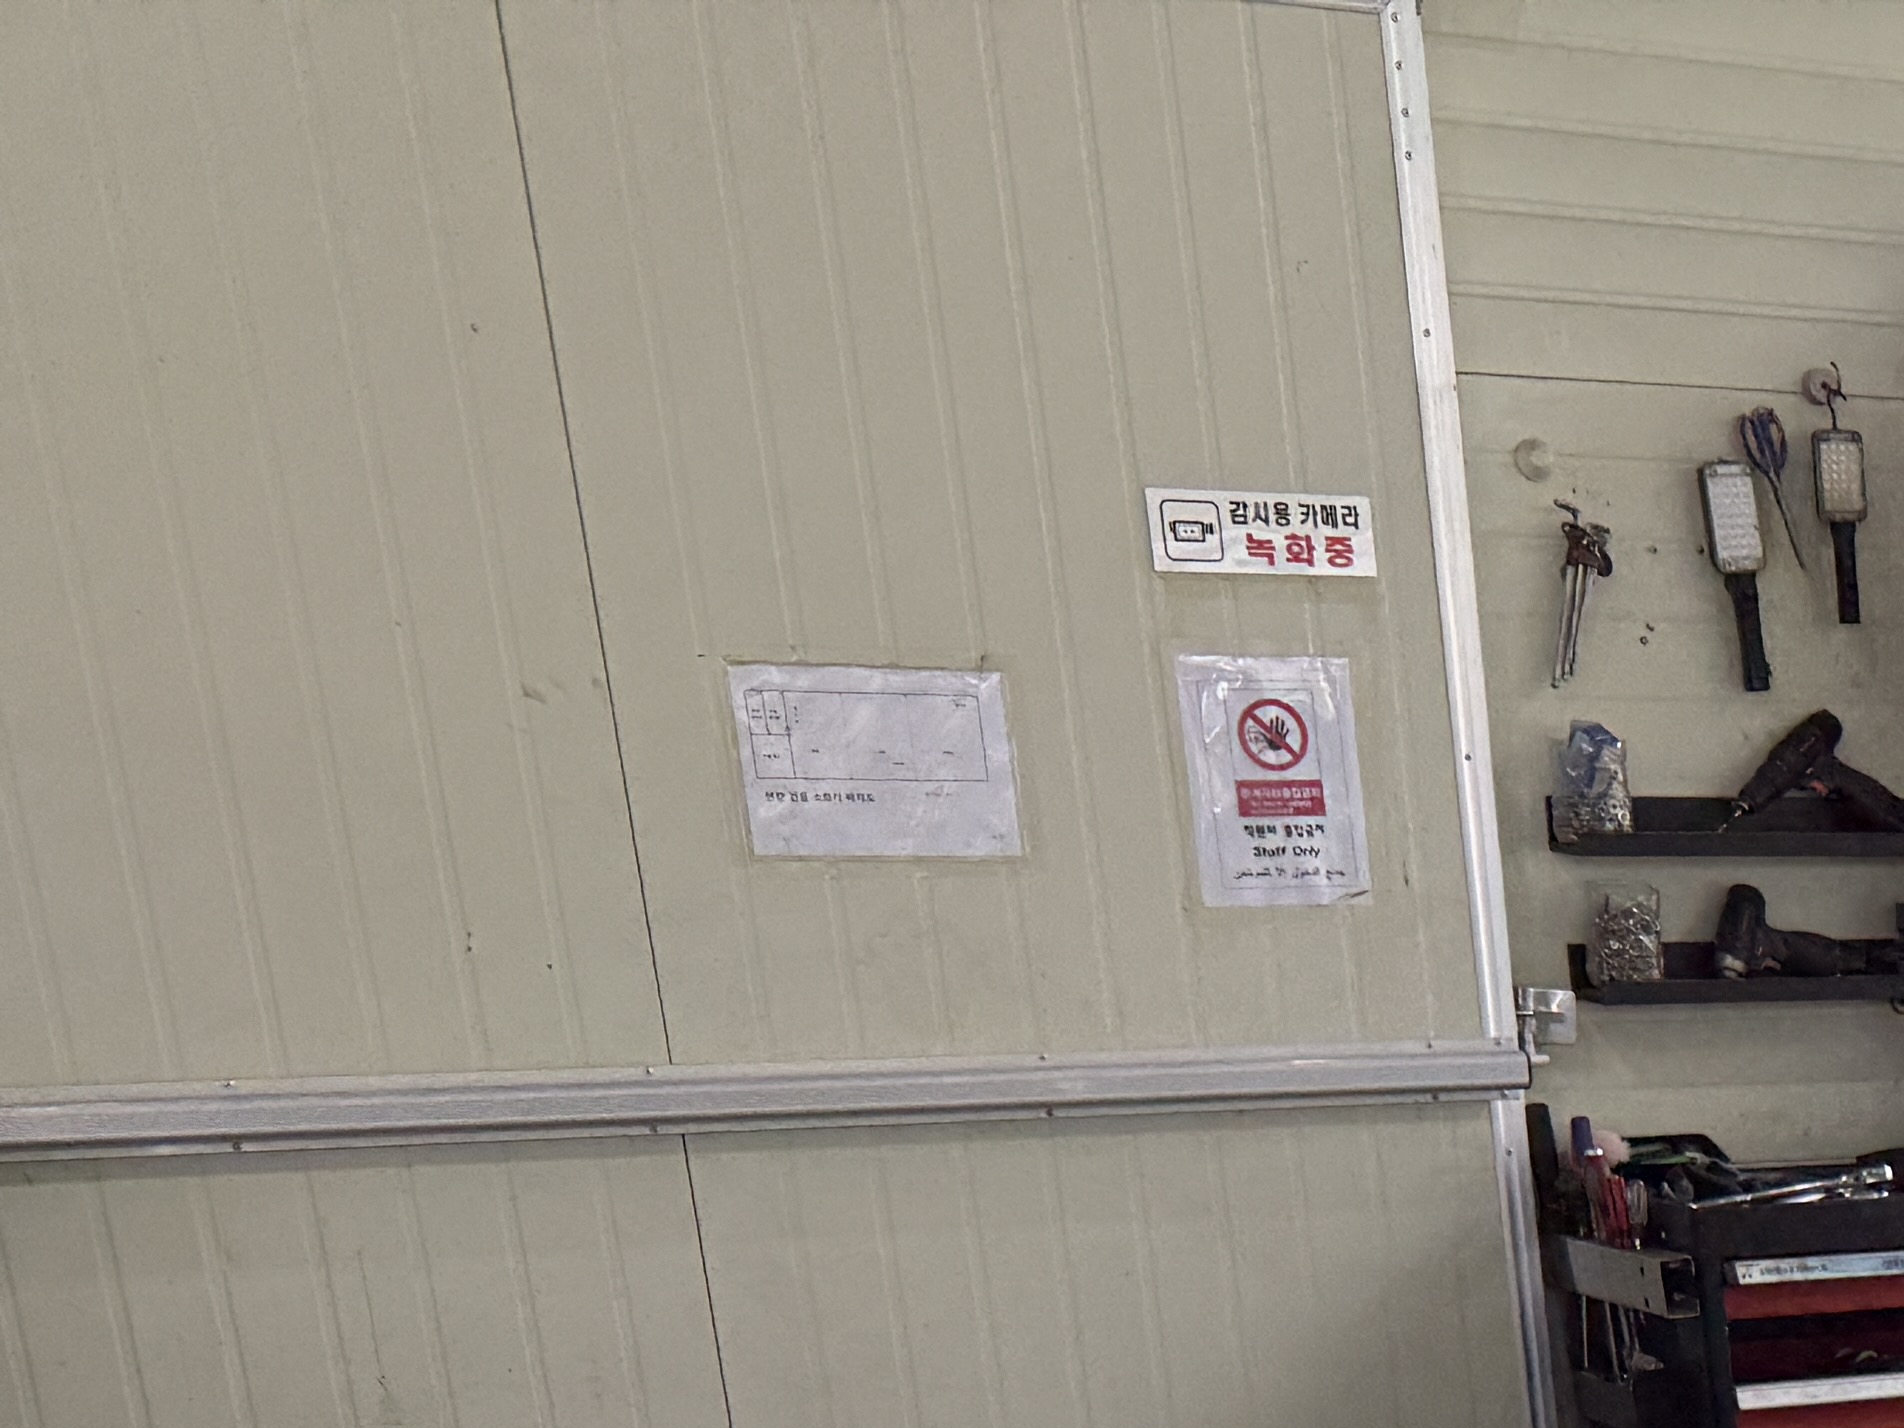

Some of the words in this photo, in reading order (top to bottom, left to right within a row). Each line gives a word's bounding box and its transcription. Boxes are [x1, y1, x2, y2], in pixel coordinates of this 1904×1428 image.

[1229, 501, 1291, 527] 감시용
[1298, 503, 1359, 530] 카메라
[1245, 532, 1354, 568] 녹화중
[1253, 846, 1286, 858] Staff
[1293, 846, 1320, 858] Only
